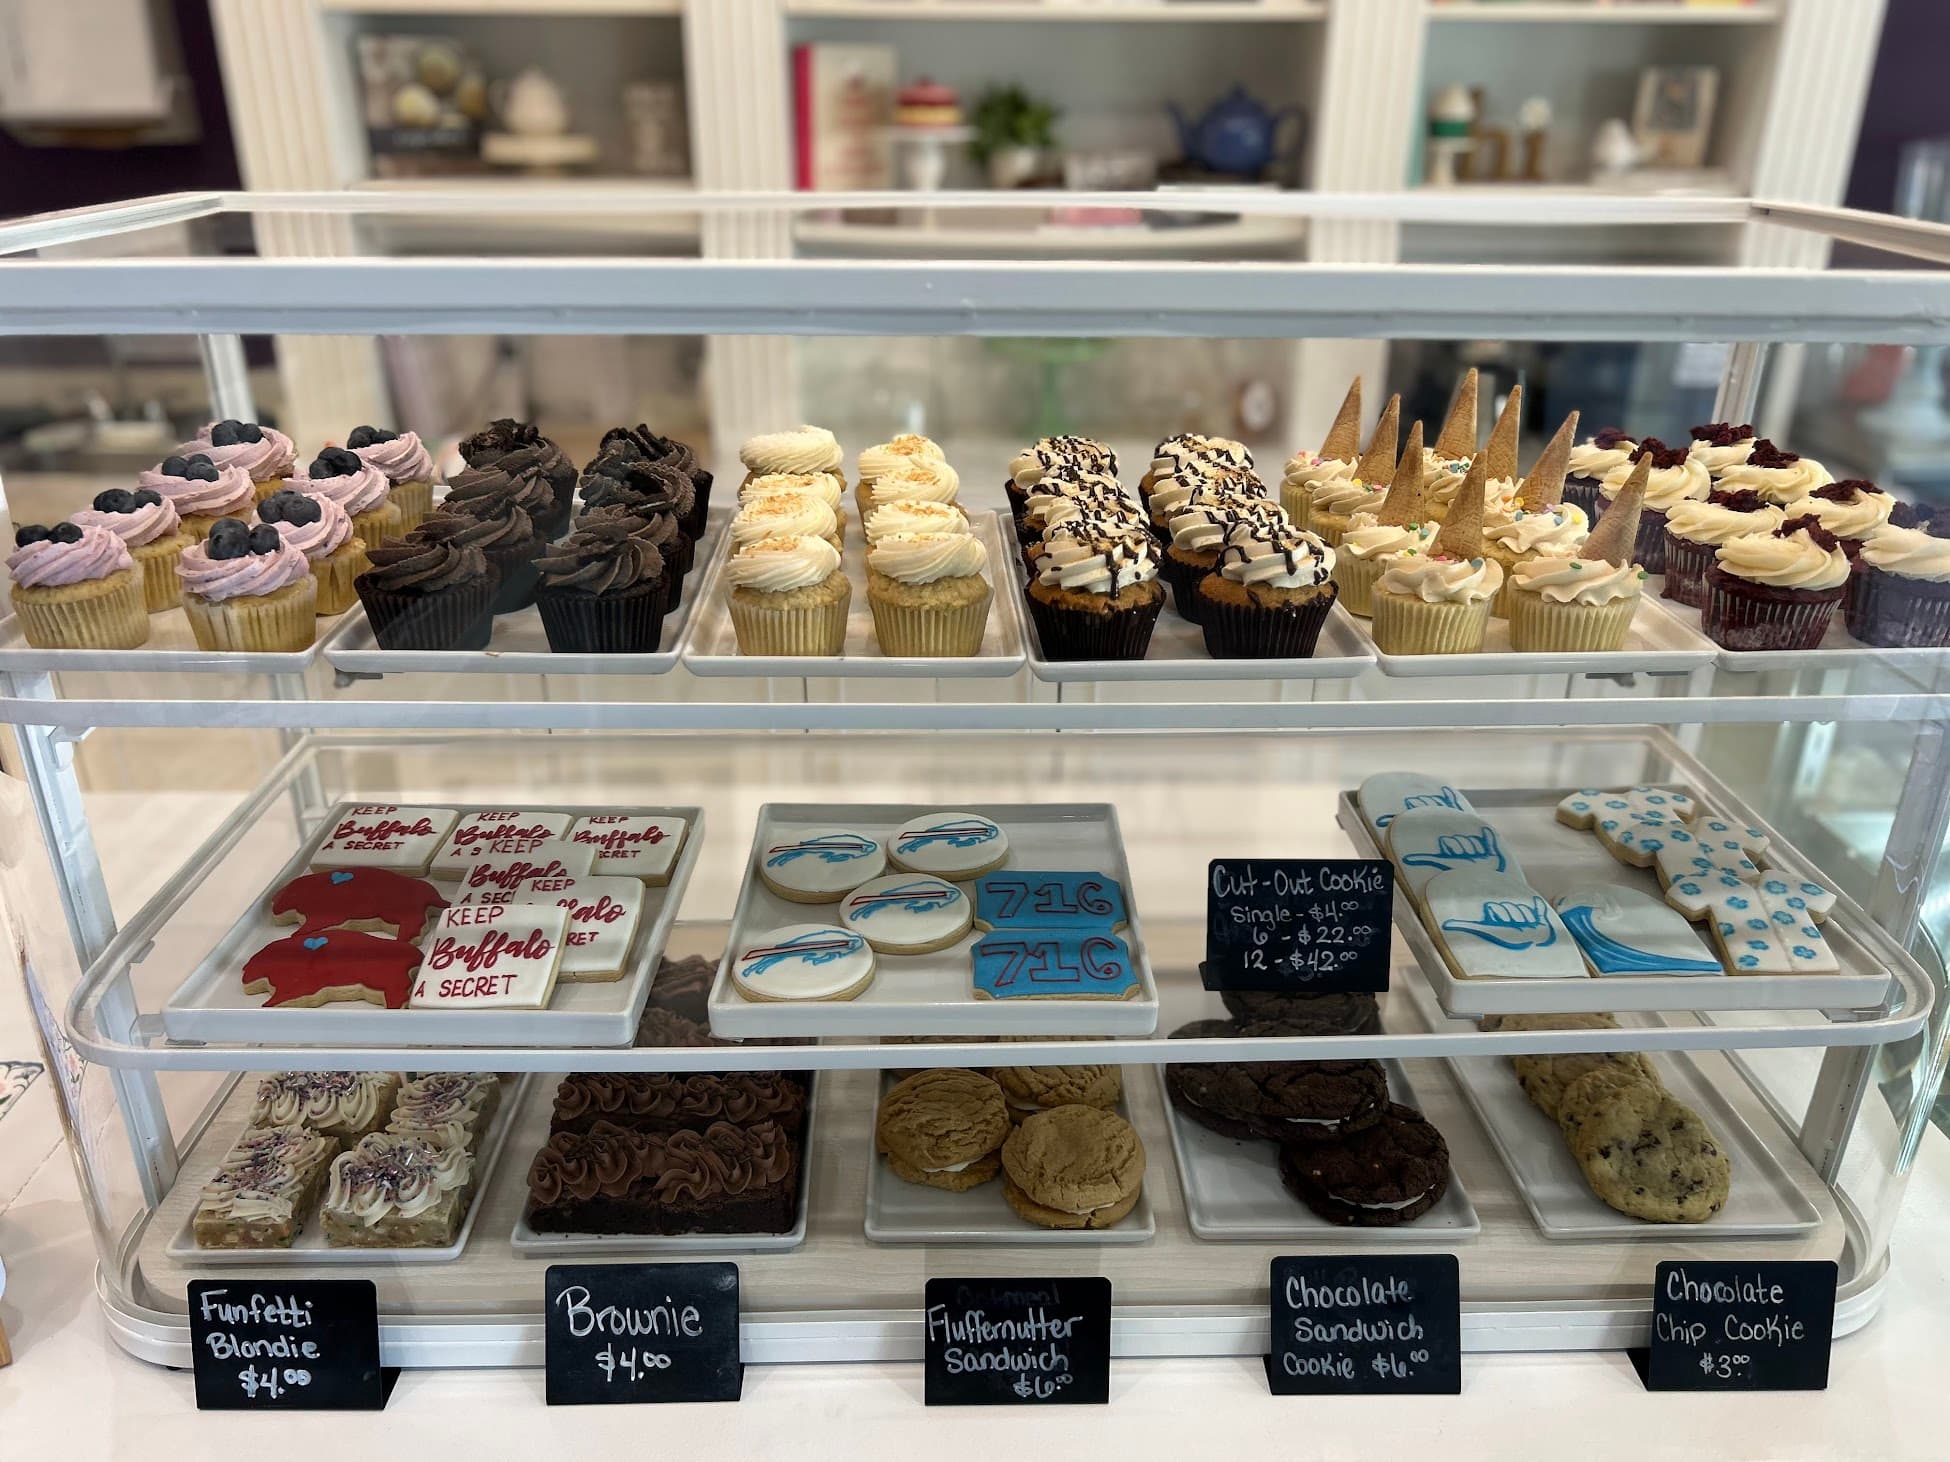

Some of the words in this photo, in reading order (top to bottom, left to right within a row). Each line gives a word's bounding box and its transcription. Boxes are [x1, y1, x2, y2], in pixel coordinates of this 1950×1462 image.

[352, 806, 397, 815] KEEP
[477, 812, 520, 821] KEEP
[589, 816, 629, 824] KEEP
[334, 818, 437, 841] Buffalo
[573, 826, 671, 849] Buffalo
[323, 841, 334, 850] A
[344, 841, 404, 850] SECRET
[450, 848, 461, 856] A
[489, 839, 543, 854] KEEP
[599, 850, 641, 859] ECRET
[531, 878, 575, 892] KEEP
[1319, 865, 1384, 893] Cookie
[461, 893, 472, 904] A
[481, 891, 517, 904] SEC
[986, 882, 1113, 918] 716
[446, 906, 504, 927] KEEP
[1230, 905, 1292, 931] Single
[1308, 900, 1360, 923] $4.00
[566, 931, 600, 946] RET
[1252, 926, 1269, 946] 6
[428, 928, 555, 972] Buffalo
[981, 937, 1122, 986] 716
[1244, 949, 1268, 969] 12
[1289, 948, 1358, 972] $42.00
[414, 981, 426, 998] A
[439, 974, 517, 998] SECRET
[1286, 1276, 1413, 1309] Chocolate
[1667, 1268, 1784, 1304] Chocolate
[200, 1289, 313, 1328] Funfetti
[556, 1286, 703, 1337] Brownie
[928, 1304, 1083, 1343] Fluffernutter
[1294, 1314, 1424, 1342] Sandwich
[1656, 1312, 1707, 1347] Chip
[1724, 1314, 1805, 1347] Cookie
[206, 1332, 321, 1359] Blondie
[944, 1343, 1069, 1374] Sandwich
[595, 1342, 672, 1382] $4.00
[1283, 1352, 1355, 1379] Cookie
[1371, 1349, 1430, 1378] $6.00
[1699, 1352, 1750, 1378] $3.00
[238, 1364, 312, 1399] $4.00
[1013, 1373, 1073, 1398] $6.00
